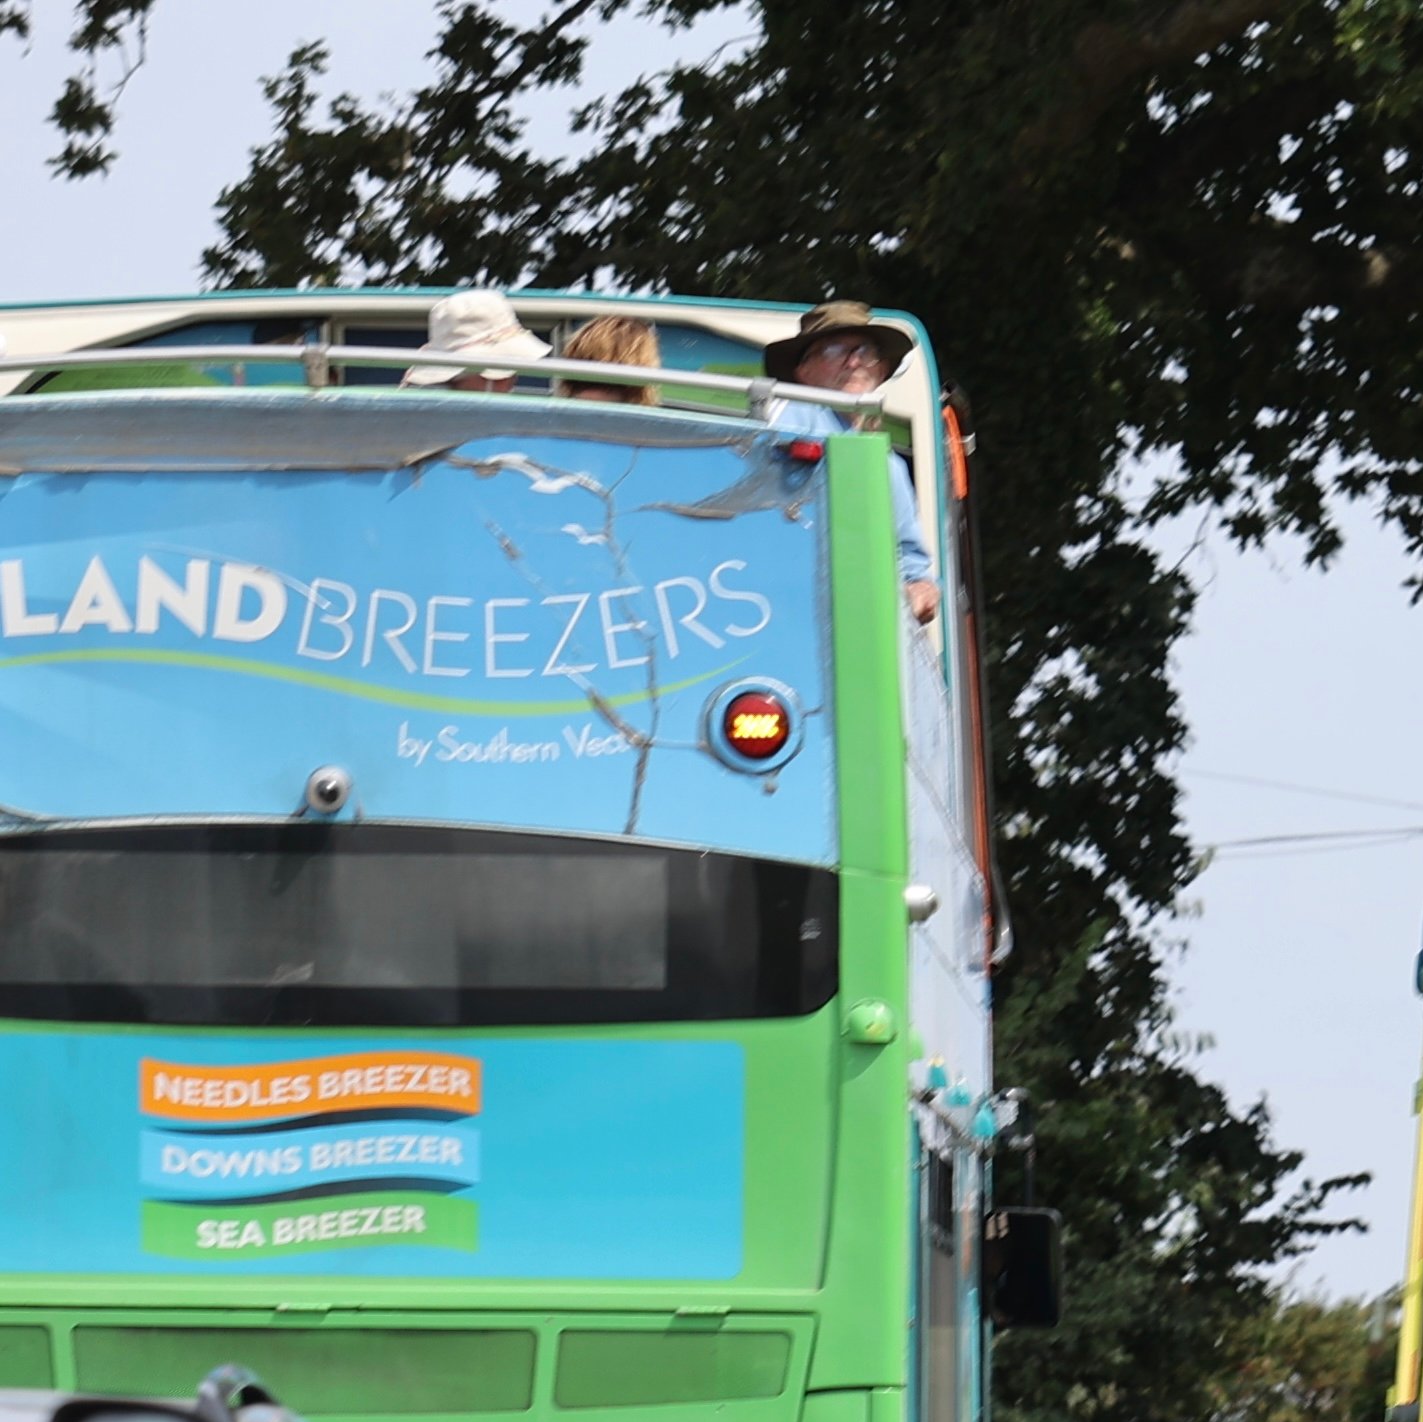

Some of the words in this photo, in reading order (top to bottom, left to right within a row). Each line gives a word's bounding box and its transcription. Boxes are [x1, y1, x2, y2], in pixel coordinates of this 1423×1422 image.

[297, 558, 772, 677] BREEZERS
[397, 720, 432, 768] by
[436, 724, 561, 763] Southern
[152, 1071, 311, 1108] NEEDLES
[317, 1064, 473, 1099] BREEZER
[161, 1145, 302, 1178] DOWNS
[309, 1135, 464, 1170] BREEZER
[195, 1220, 266, 1250] SEA
[272, 1205, 427, 1246] BREEZER
